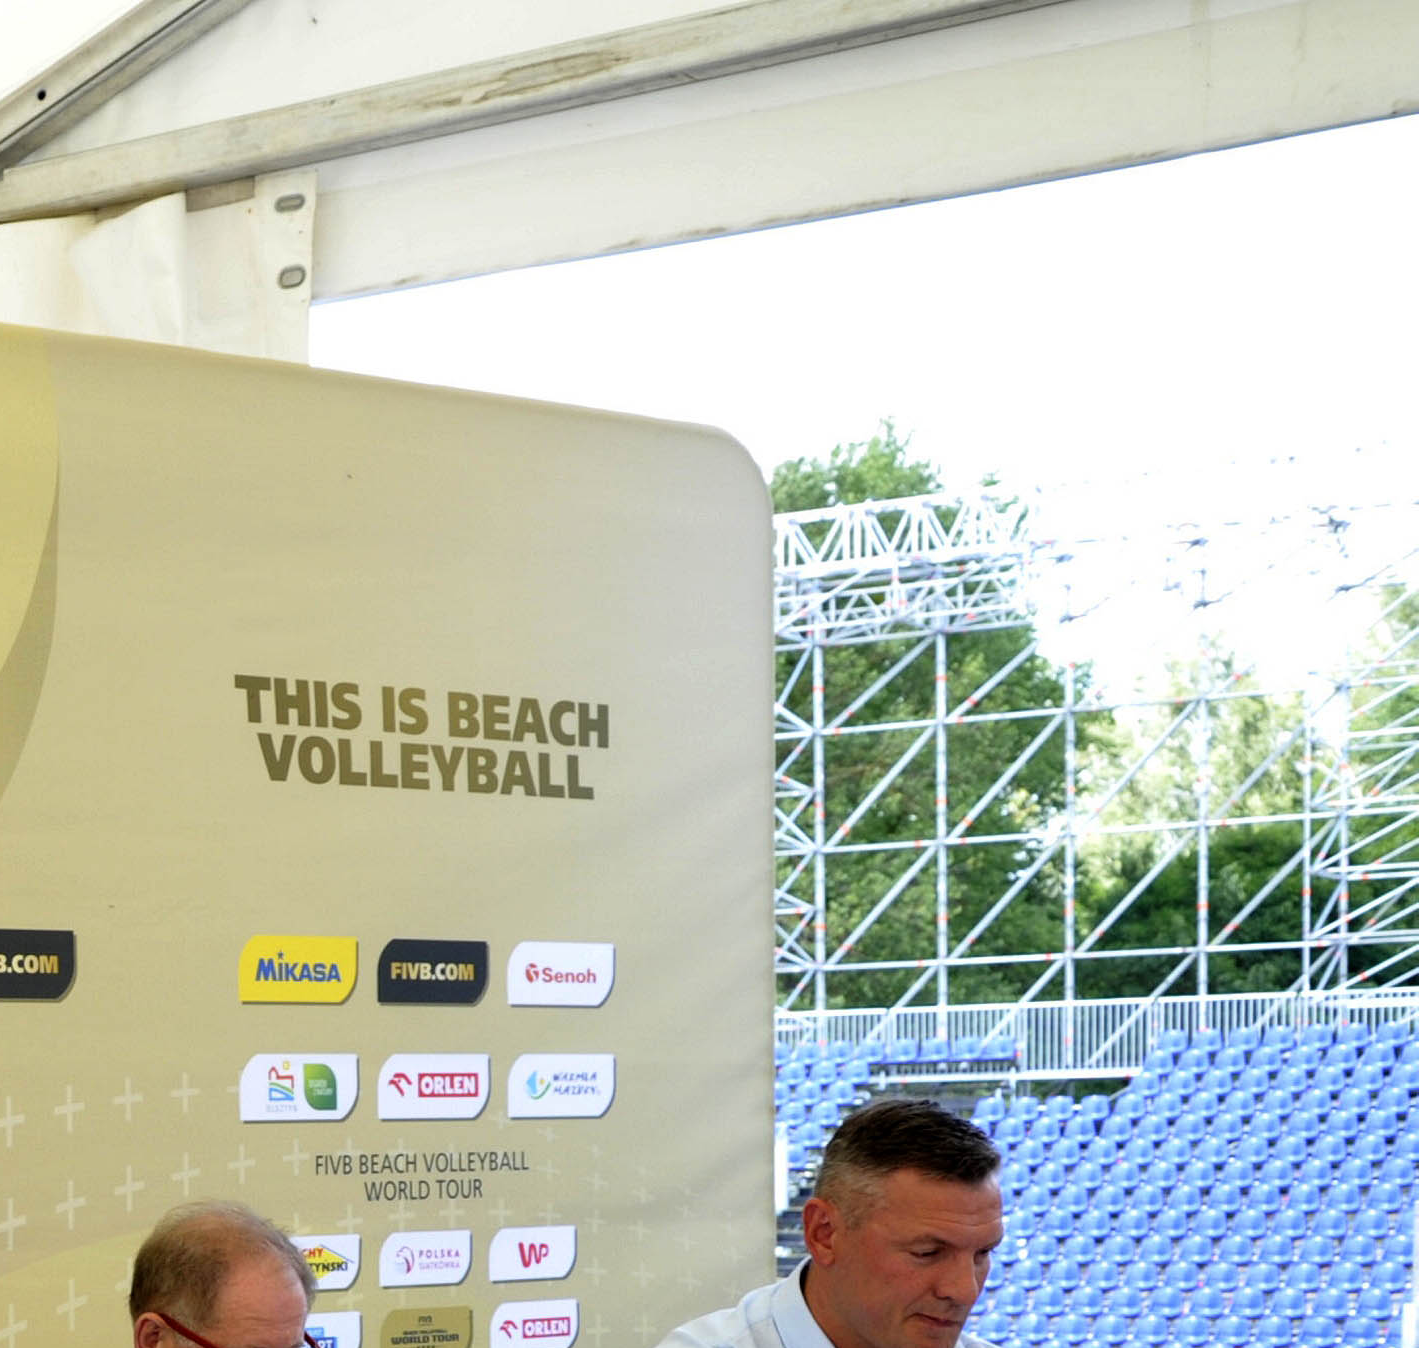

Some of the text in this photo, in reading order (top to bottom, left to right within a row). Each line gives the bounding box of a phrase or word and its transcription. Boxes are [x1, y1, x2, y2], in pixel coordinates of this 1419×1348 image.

[235, 674, 609, 748] THIS IS BEACH
[258, 733, 594, 800] VOLLEYBALL
[391, 962, 474, 980] FIVB.COM
[542, 967, 596, 984] Senoh
[420, 1075, 475, 1095] ORLEN
[315, 1150, 529, 1176] FIVB BEACH VOLLEYBALL
[364, 1179, 483, 1201] WORLD TOUR
[419, 1250, 460, 1259] POLSKA
[519, 1241, 549, 1268] WP
[524, 1319, 569, 1337] ORLEN
[391, 1334, 459, 1345] WORLD TOUR
